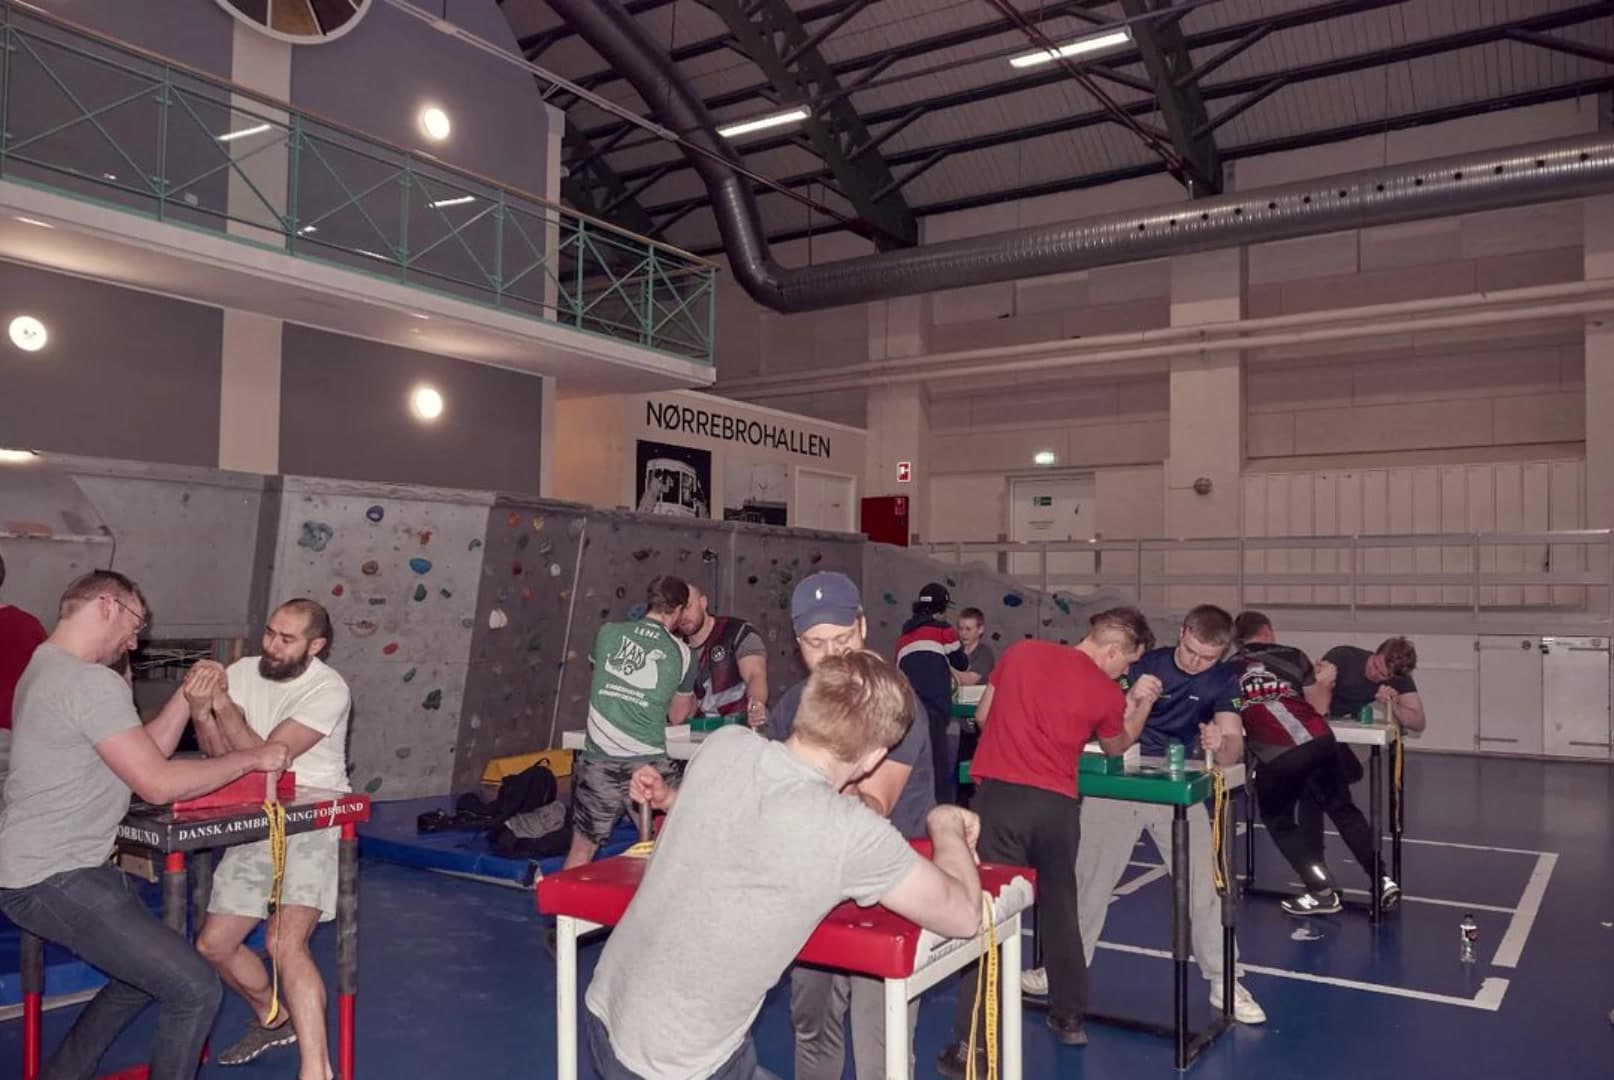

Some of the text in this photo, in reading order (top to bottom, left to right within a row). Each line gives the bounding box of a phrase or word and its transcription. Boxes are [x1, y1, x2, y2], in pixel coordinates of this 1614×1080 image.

[646, 401, 831, 458] NØRREBROHALLEN
[634, 626, 660, 640] LENZ
[179, 820, 222, 841] DANSK
